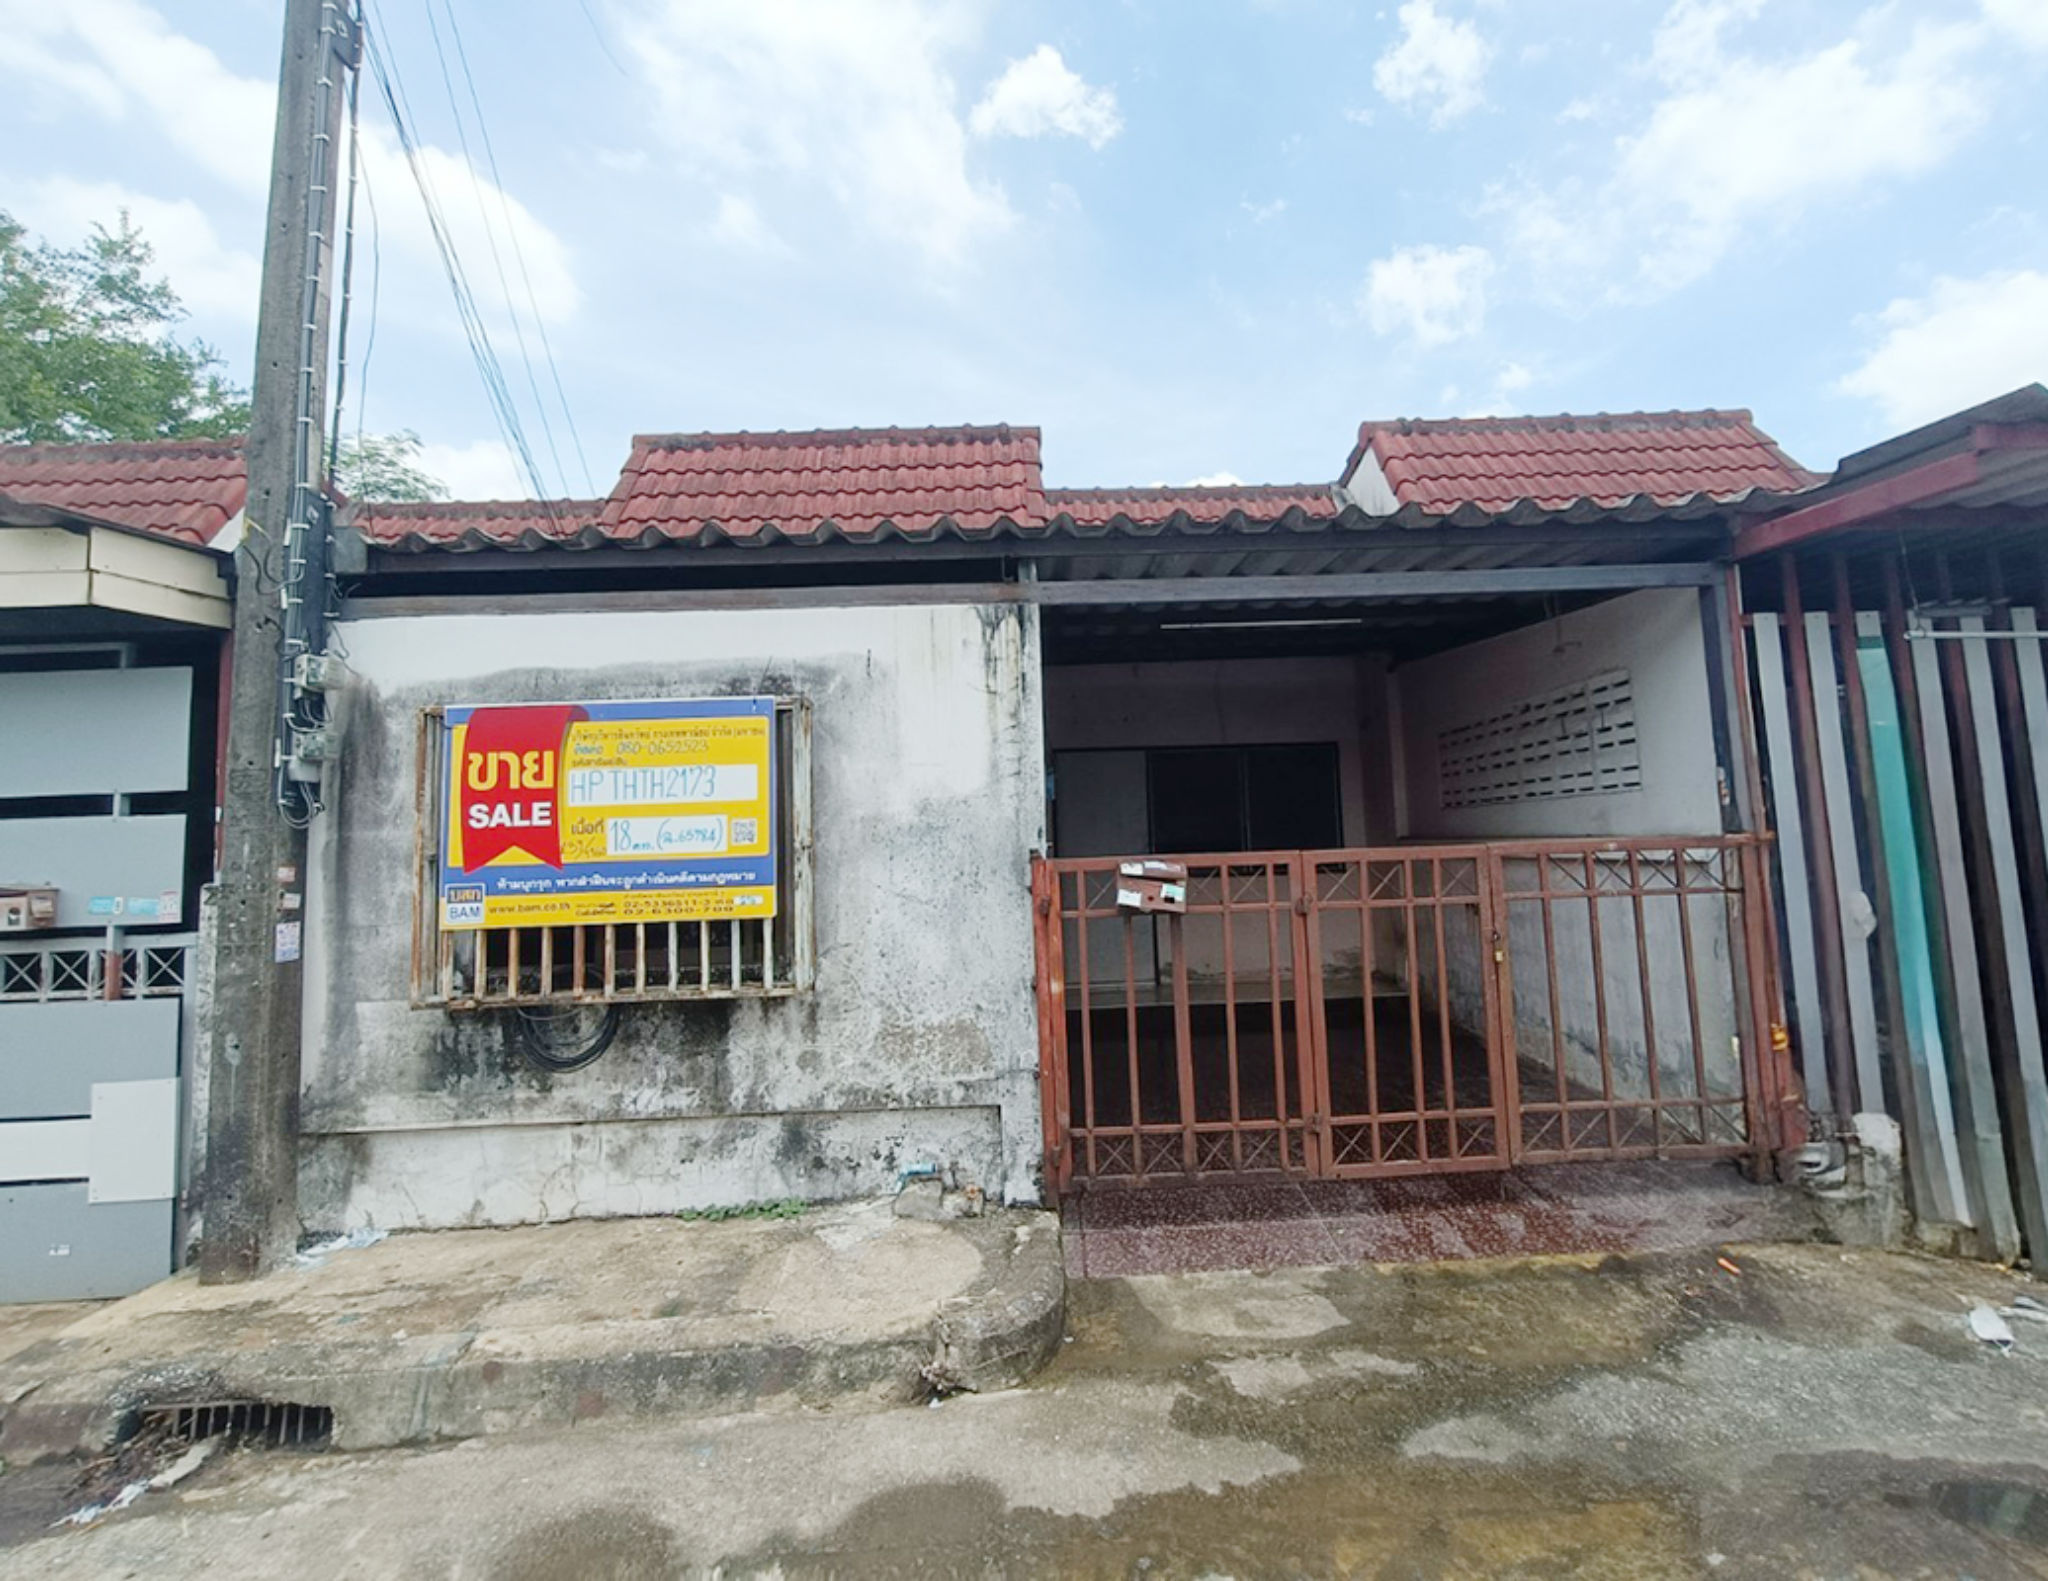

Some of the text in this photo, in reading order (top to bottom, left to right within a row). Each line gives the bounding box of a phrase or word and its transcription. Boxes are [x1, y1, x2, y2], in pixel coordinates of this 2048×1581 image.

[468, 750, 554, 791] ขาย
[468, 801, 552, 829] SALE
[571, 816, 605, 835] เนื้อที่
[449, 905, 481, 919] BAM
